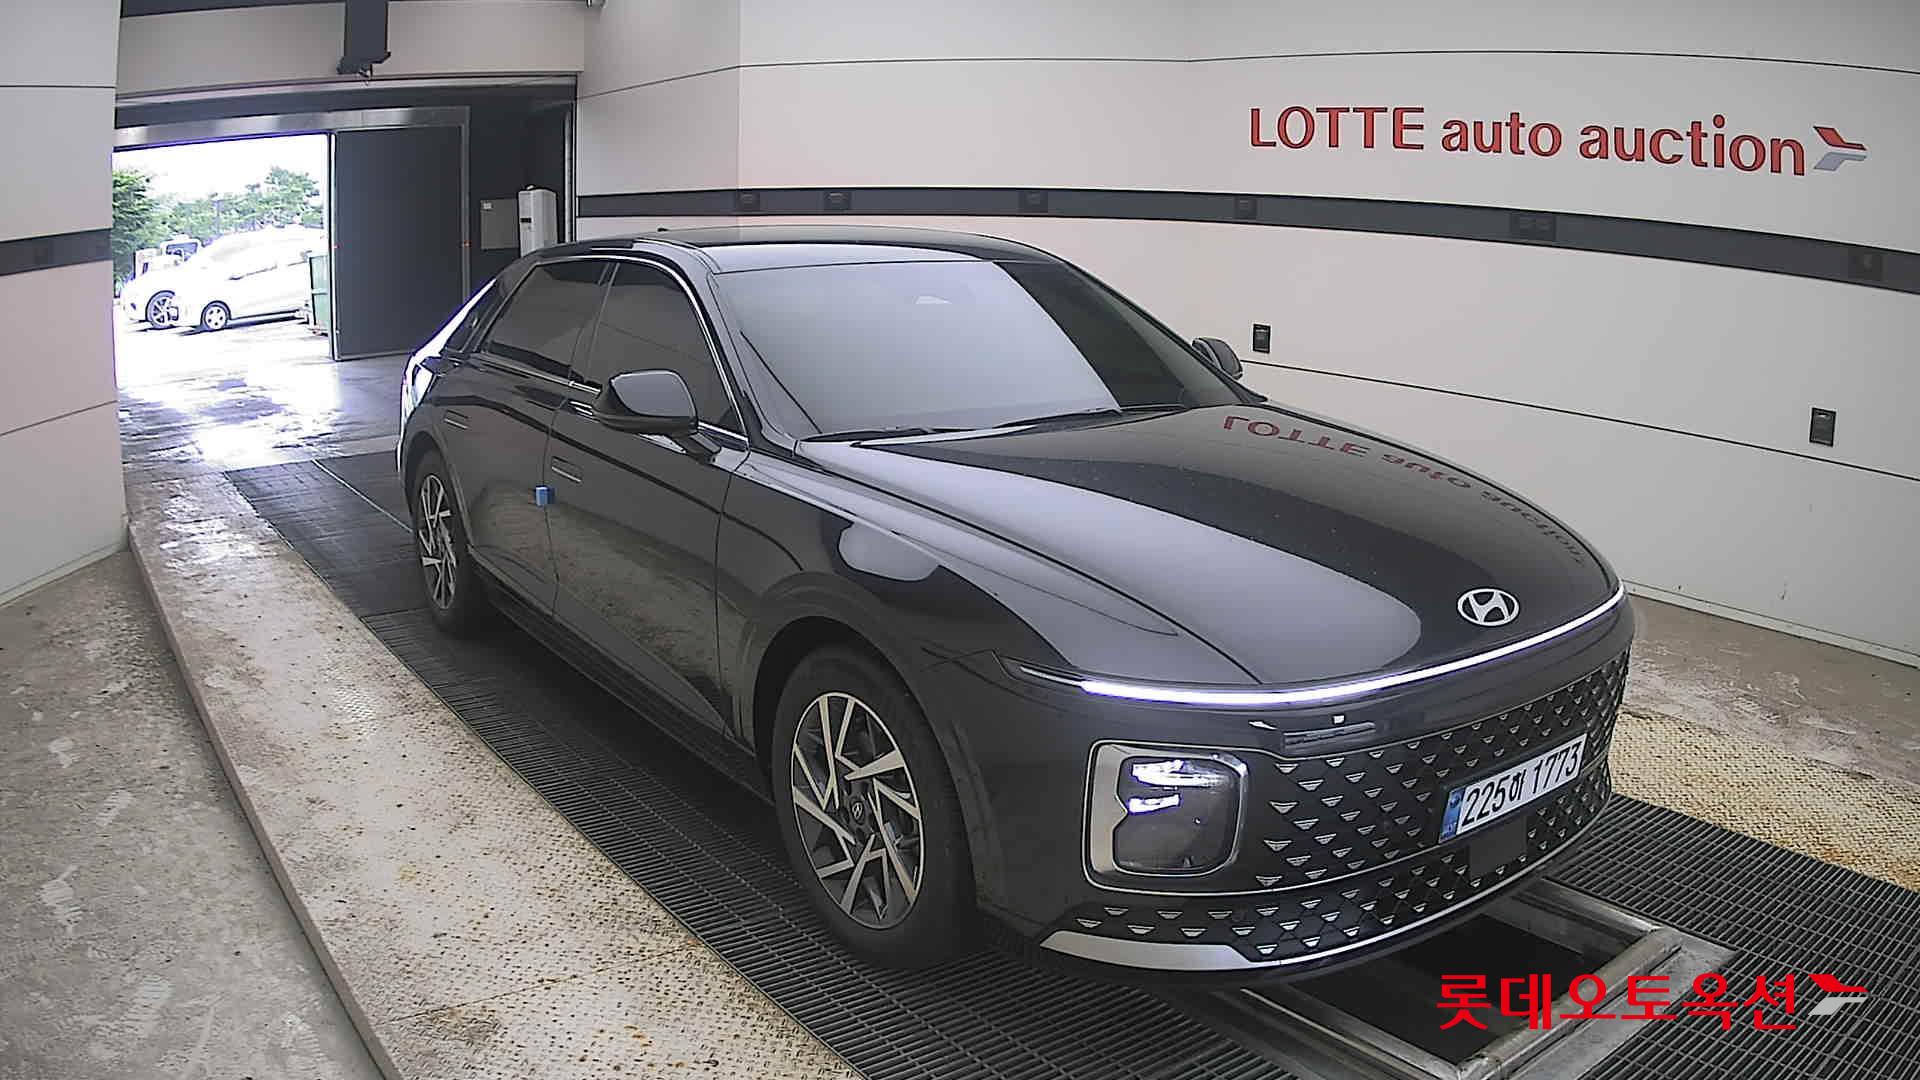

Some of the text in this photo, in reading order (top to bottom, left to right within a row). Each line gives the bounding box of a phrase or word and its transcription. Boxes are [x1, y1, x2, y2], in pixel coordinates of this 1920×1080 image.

[1250, 106, 1807, 177] LOTTE auto auction
[1532, 740, 1583, 794] 1773
